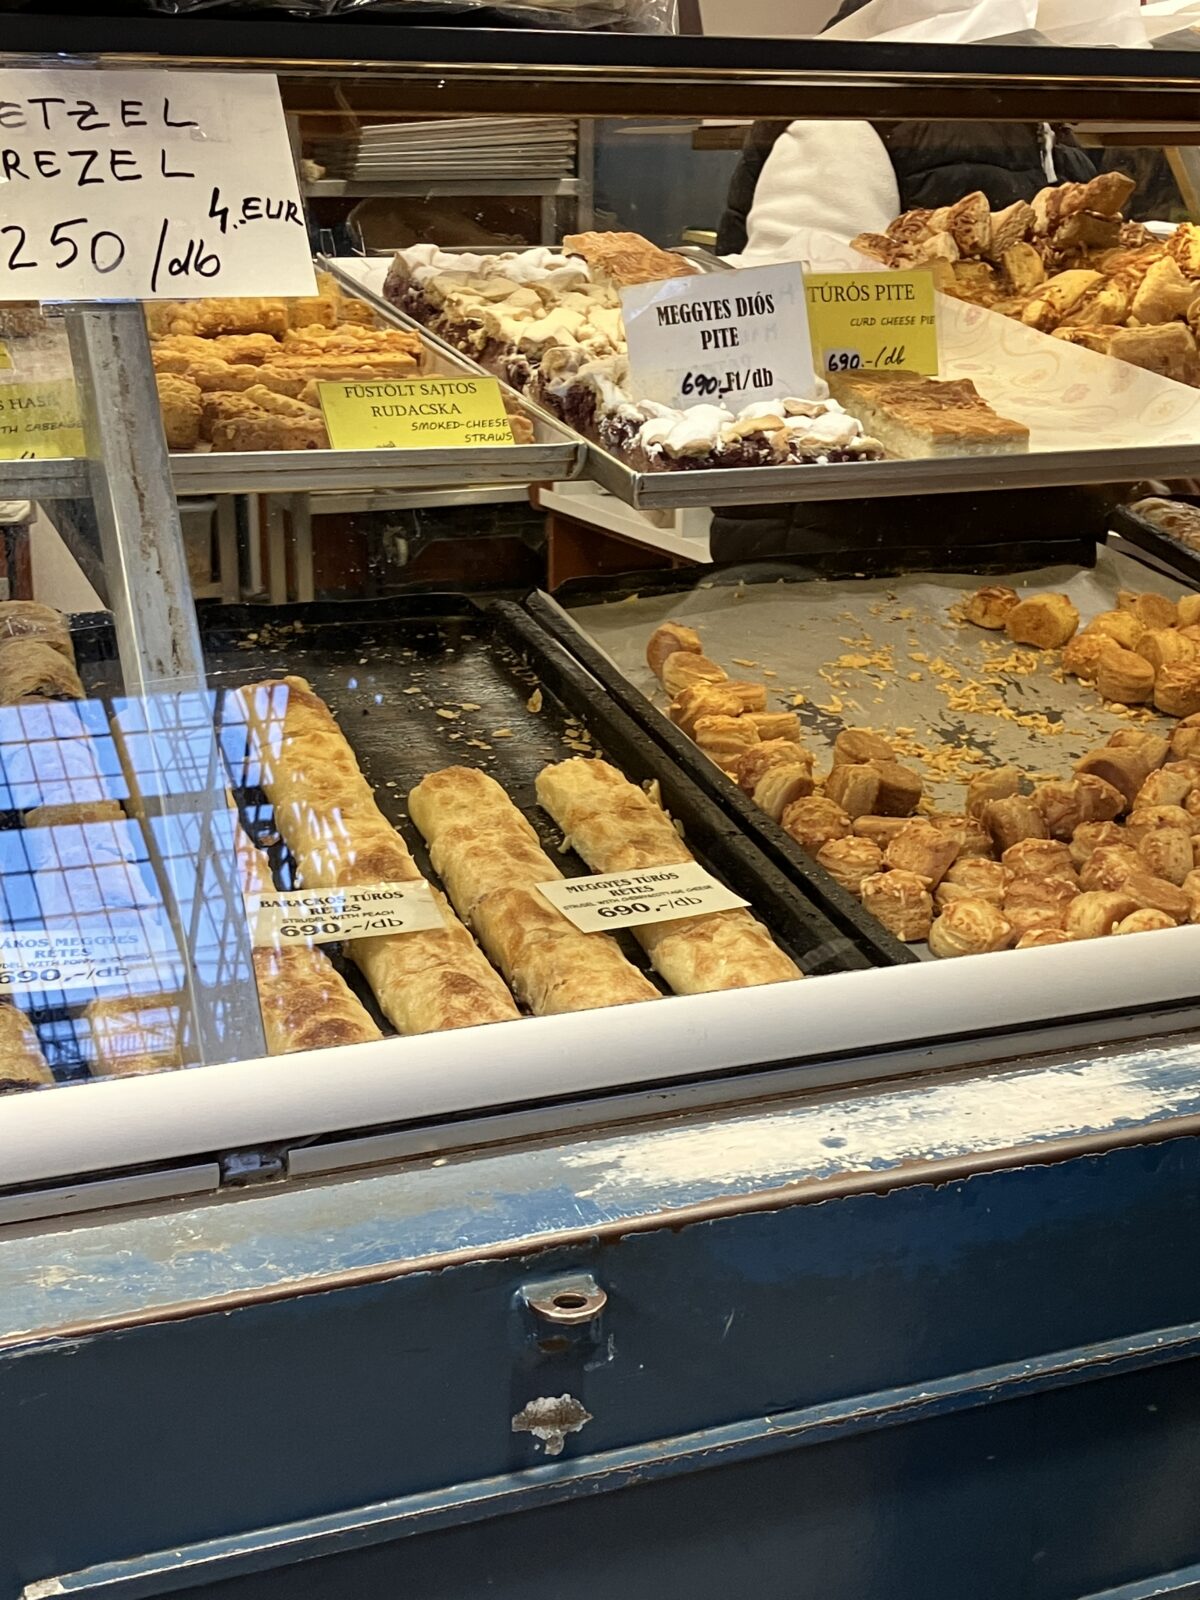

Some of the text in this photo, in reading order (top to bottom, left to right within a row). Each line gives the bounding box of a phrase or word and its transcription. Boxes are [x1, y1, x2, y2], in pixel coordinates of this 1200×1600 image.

[1, 148, 195, 187] REZEL
[806, 281, 915, 303] TÚRÓS PITE
[656, 291, 776, 327] MEGGYES DIÓS
[849, 314, 936, 327] CURD CHEESE PIE
[700, 326, 740, 350] PITE
[344, 382, 478, 399] FÜSTÖLT SAJTOS
[370, 403, 463, 418] RUDACSKA
[411, 418, 509, 432] SMOKED-CHEESE
[464, 432, 513, 444] STRAWS
[566, 878, 631, 893] MEGGYES
[350, 890, 404, 902] TÚRÓS
[330, 912, 360, 921] WITH
[362, 910, 395, 918] PEACH
